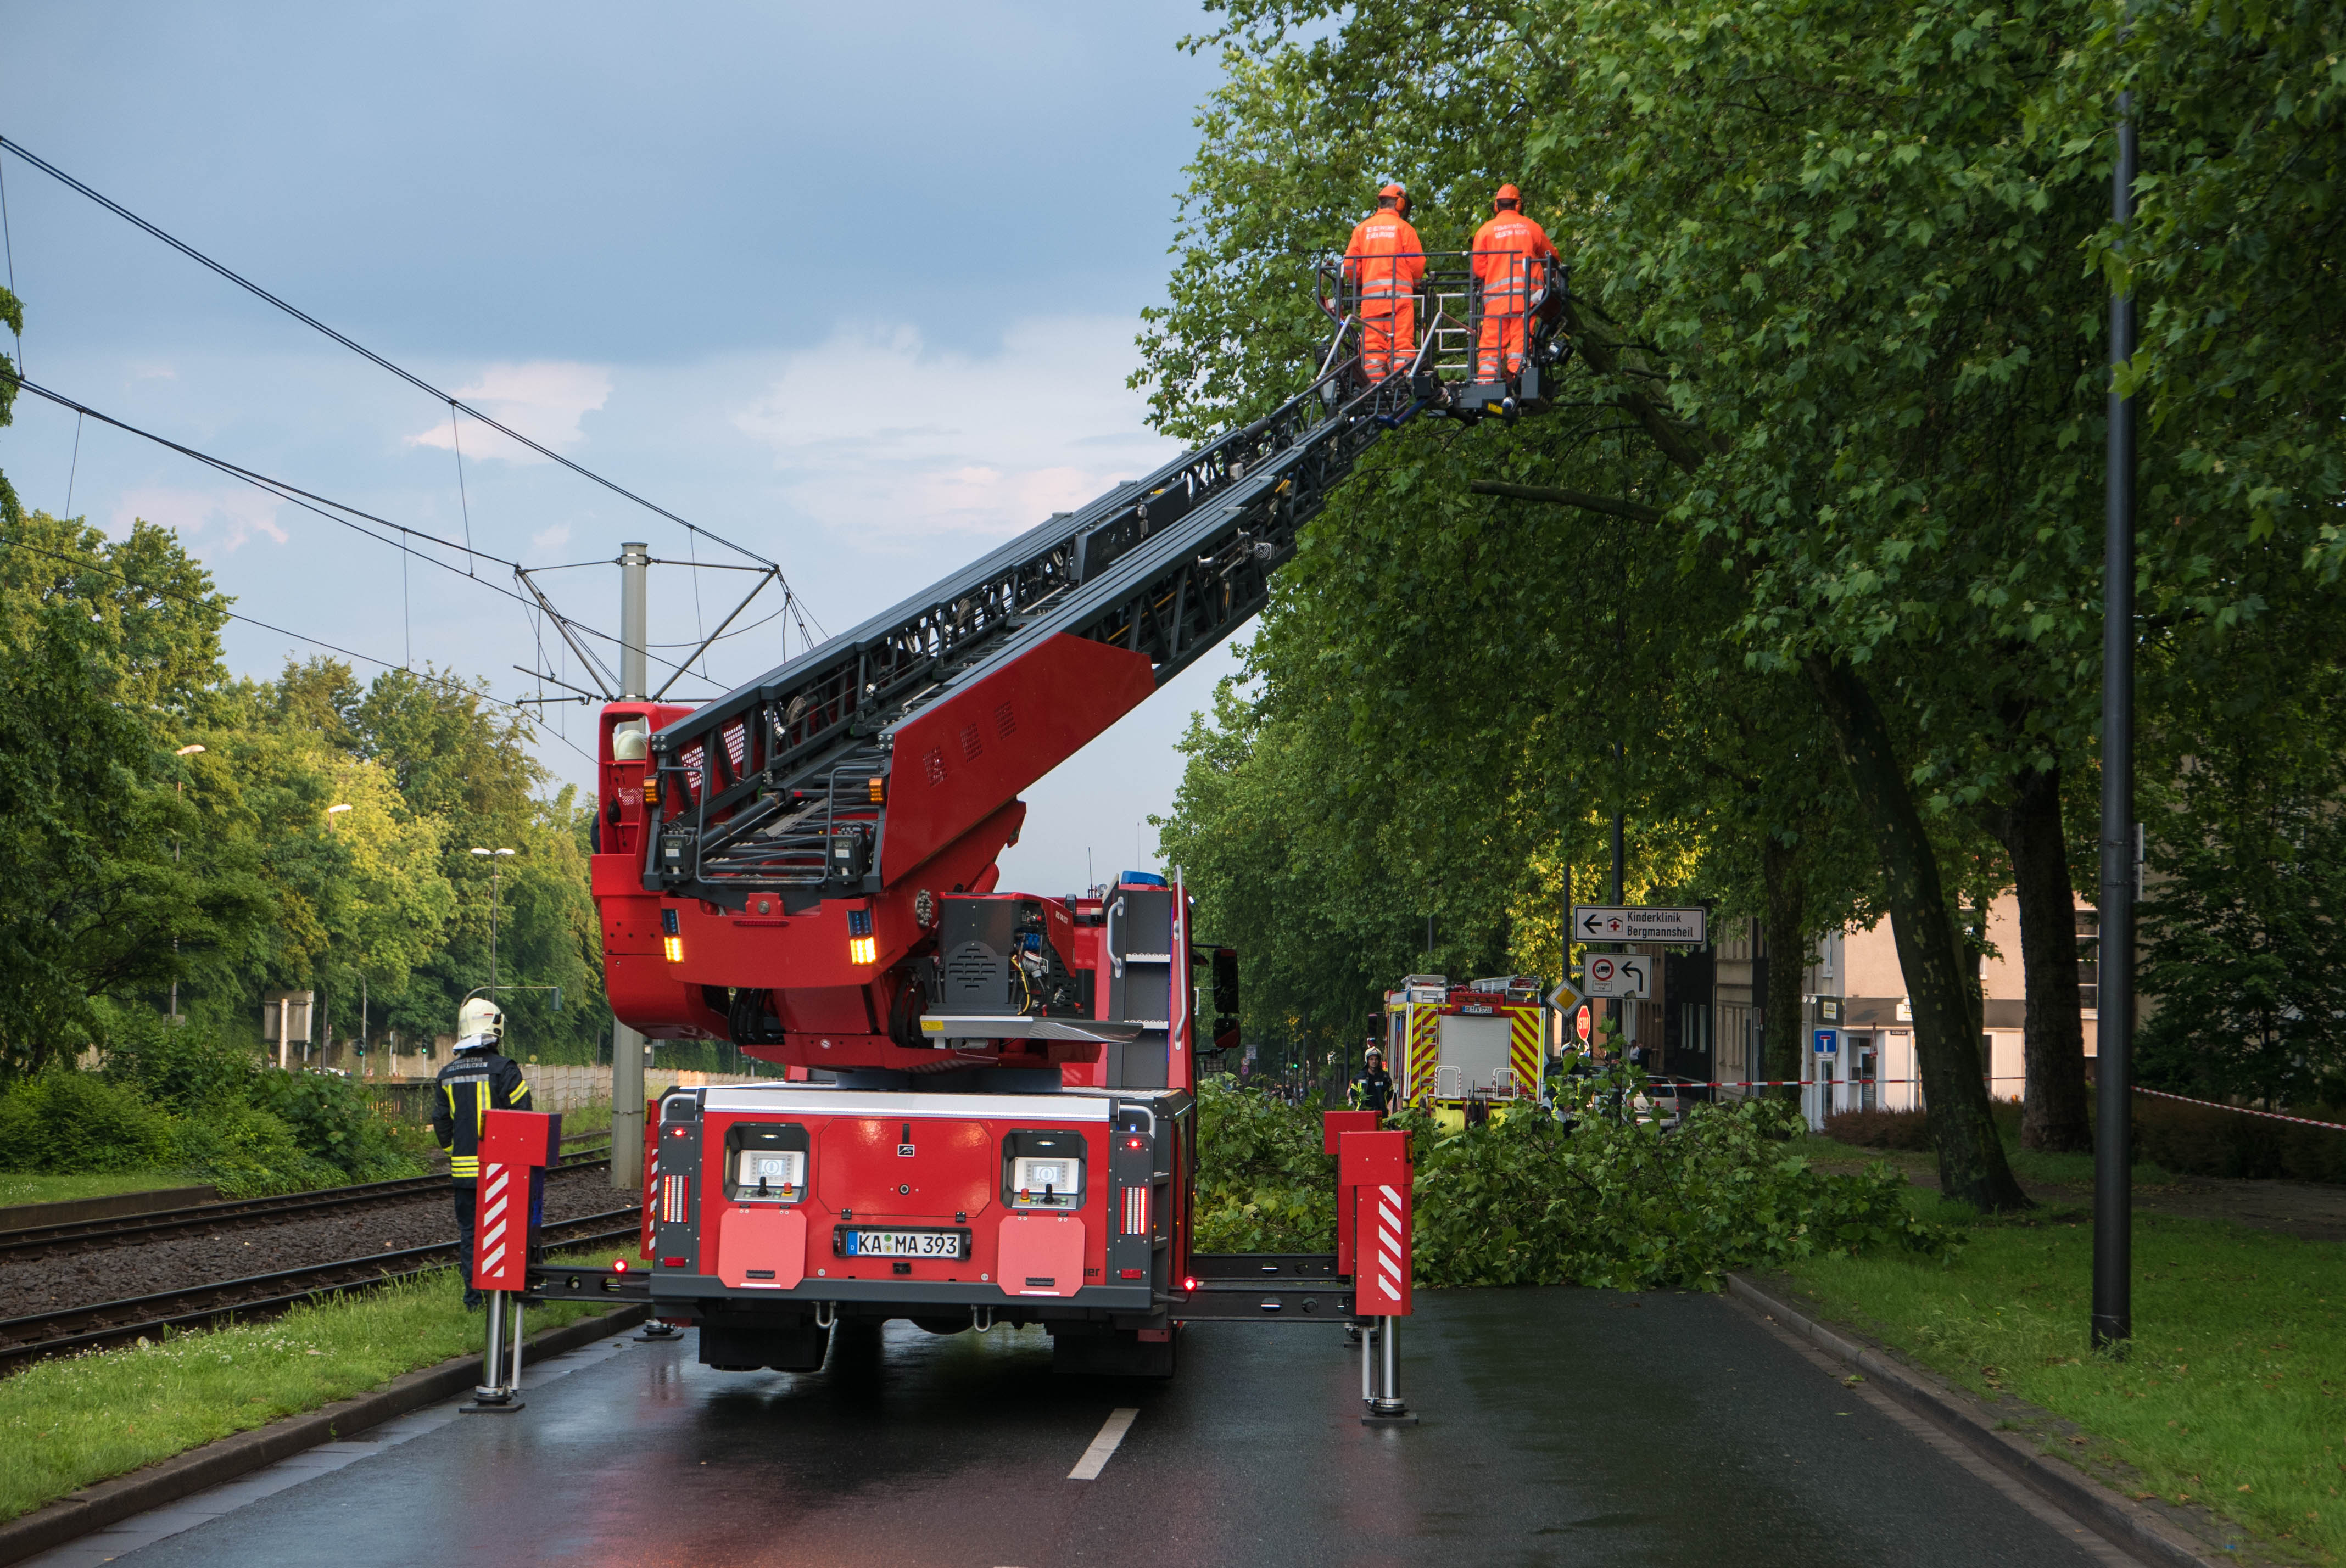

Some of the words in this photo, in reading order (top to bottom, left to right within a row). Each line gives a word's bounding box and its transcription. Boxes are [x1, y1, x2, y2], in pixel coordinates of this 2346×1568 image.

[1627, 911, 1682, 923] Kinderklinik
[1627, 926, 1694, 938] Bergmannsheil
[1579, 1017, 1589, 1029] STOP
[859, 1235, 882, 1253] KA
[895, 1236, 918, 1253] MA
[923, 1236, 957, 1254] 393
